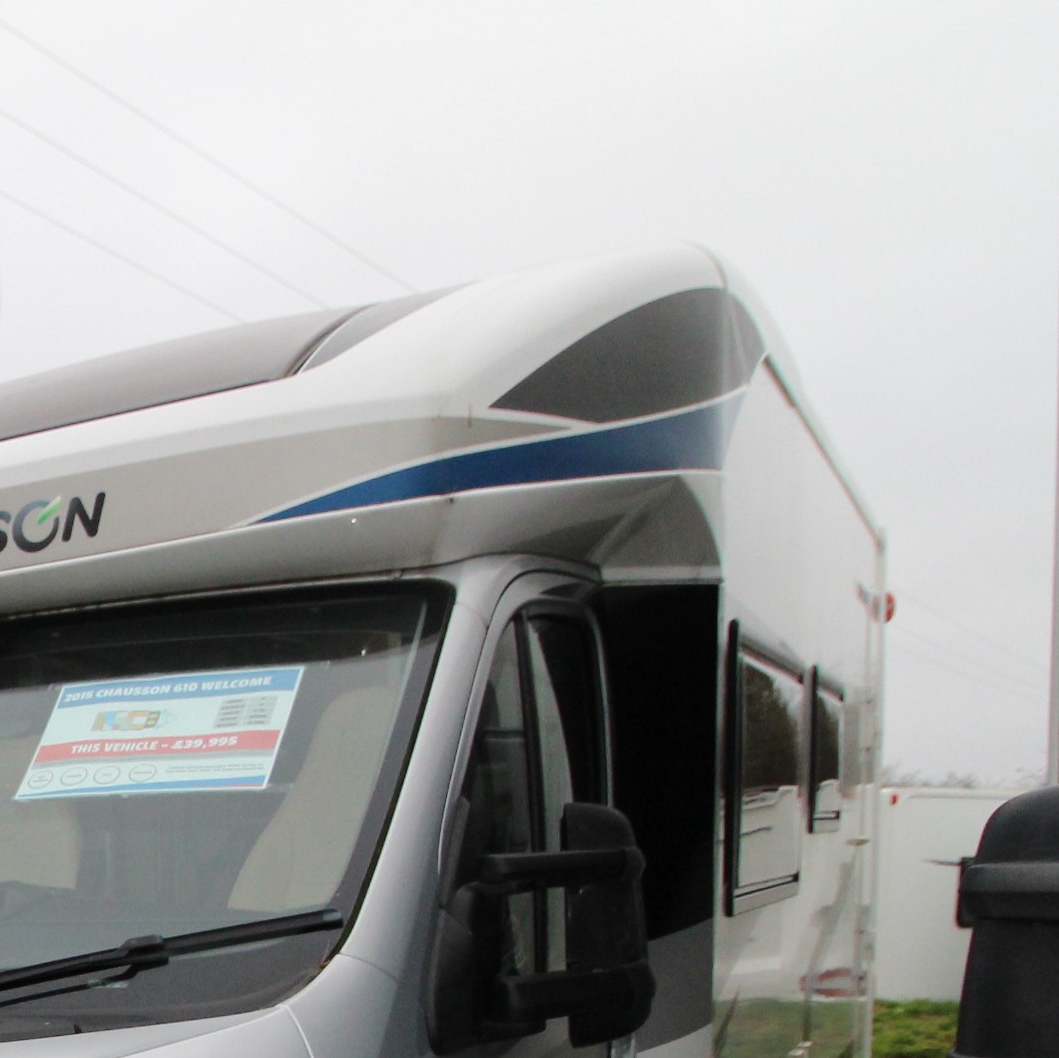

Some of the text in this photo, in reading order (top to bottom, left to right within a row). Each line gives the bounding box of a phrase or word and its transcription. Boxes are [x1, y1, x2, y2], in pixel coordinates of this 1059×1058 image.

[65, 676, 273, 702] 2015 CHAUSSON 610 WELCOME
[71, 743, 100, 754] THIS
[104, 740, 159, 753] VEHICLE
[171, 736, 239, 751] £39,995
